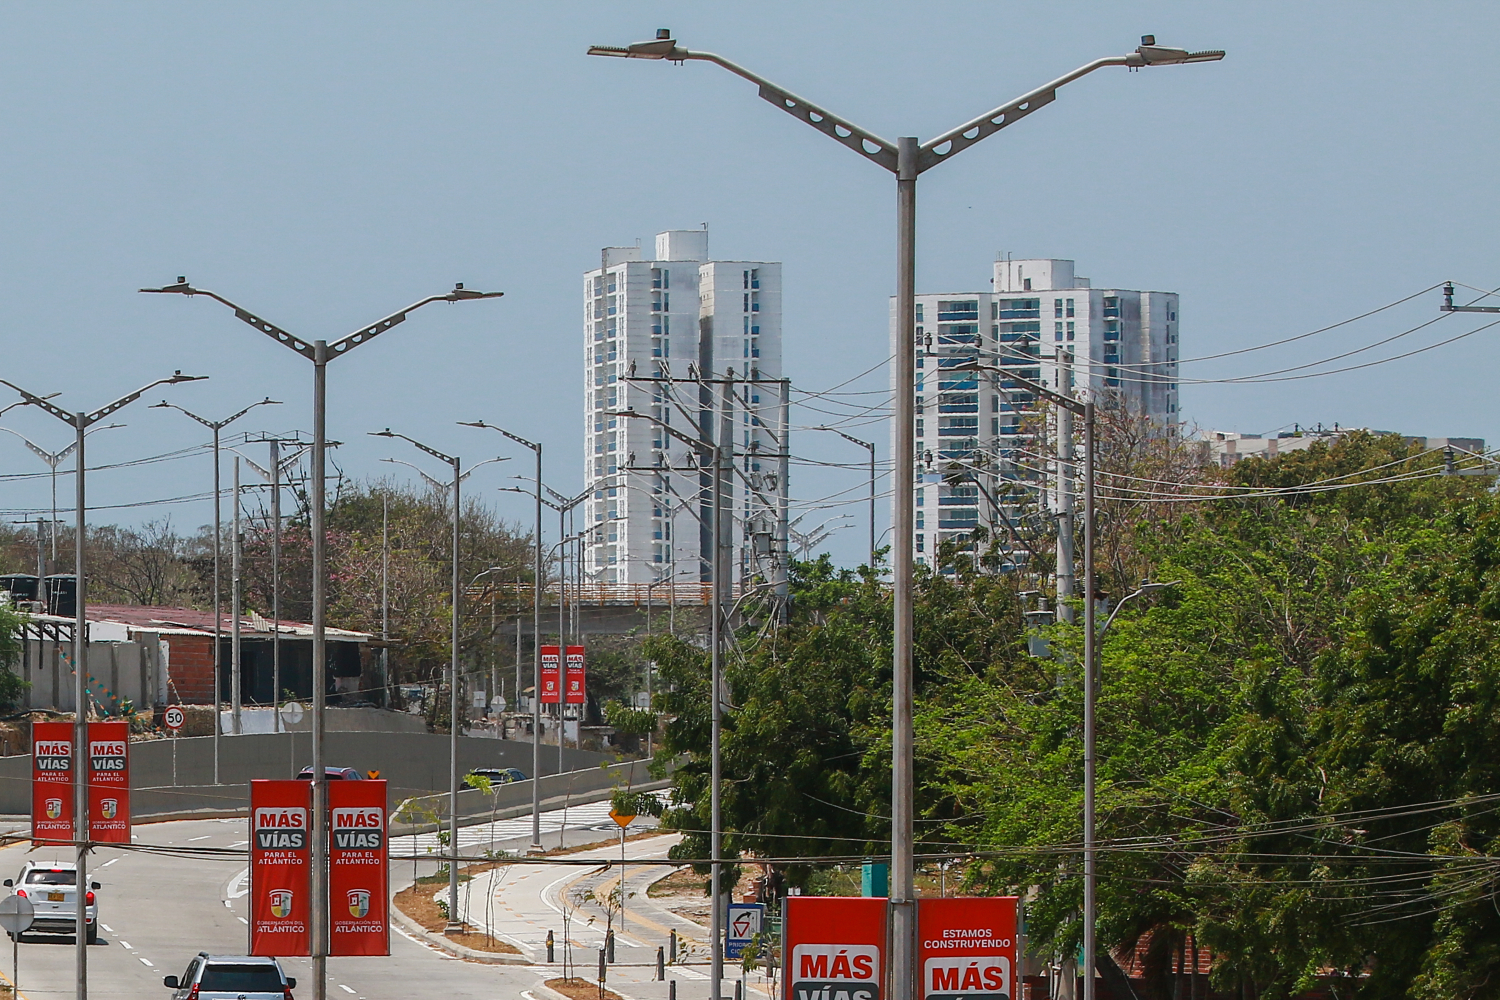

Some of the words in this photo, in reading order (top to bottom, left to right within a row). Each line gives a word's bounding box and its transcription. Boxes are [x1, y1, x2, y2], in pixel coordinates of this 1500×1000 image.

[168, 713, 182, 723] 50
[39, 743, 69, 755] MÁS
[93, 743, 124, 755] MÁS
[38, 758, 69, 769] VÍAS
[93, 758, 124, 769] VÍAS
[260, 811, 303, 827] MÁS
[337, 811, 380, 827] MÁS
[259, 831, 303, 847] VÍAS
[336, 831, 380, 847] VÍAS
[258, 857, 303, 865] ATLÁNTICO
[336, 857, 380, 865] ATLÁNTICO
[257, 925, 305, 933] ATLÁNTICO
[335, 925, 383, 933] ATLÁNTICO
[942, 928, 993, 938] ESTAMOS
[924, 939, 1011, 949] CONSTRUYENDO
[800, 949, 873, 980] MÁS
[932, 962, 1003, 991] MÁS
